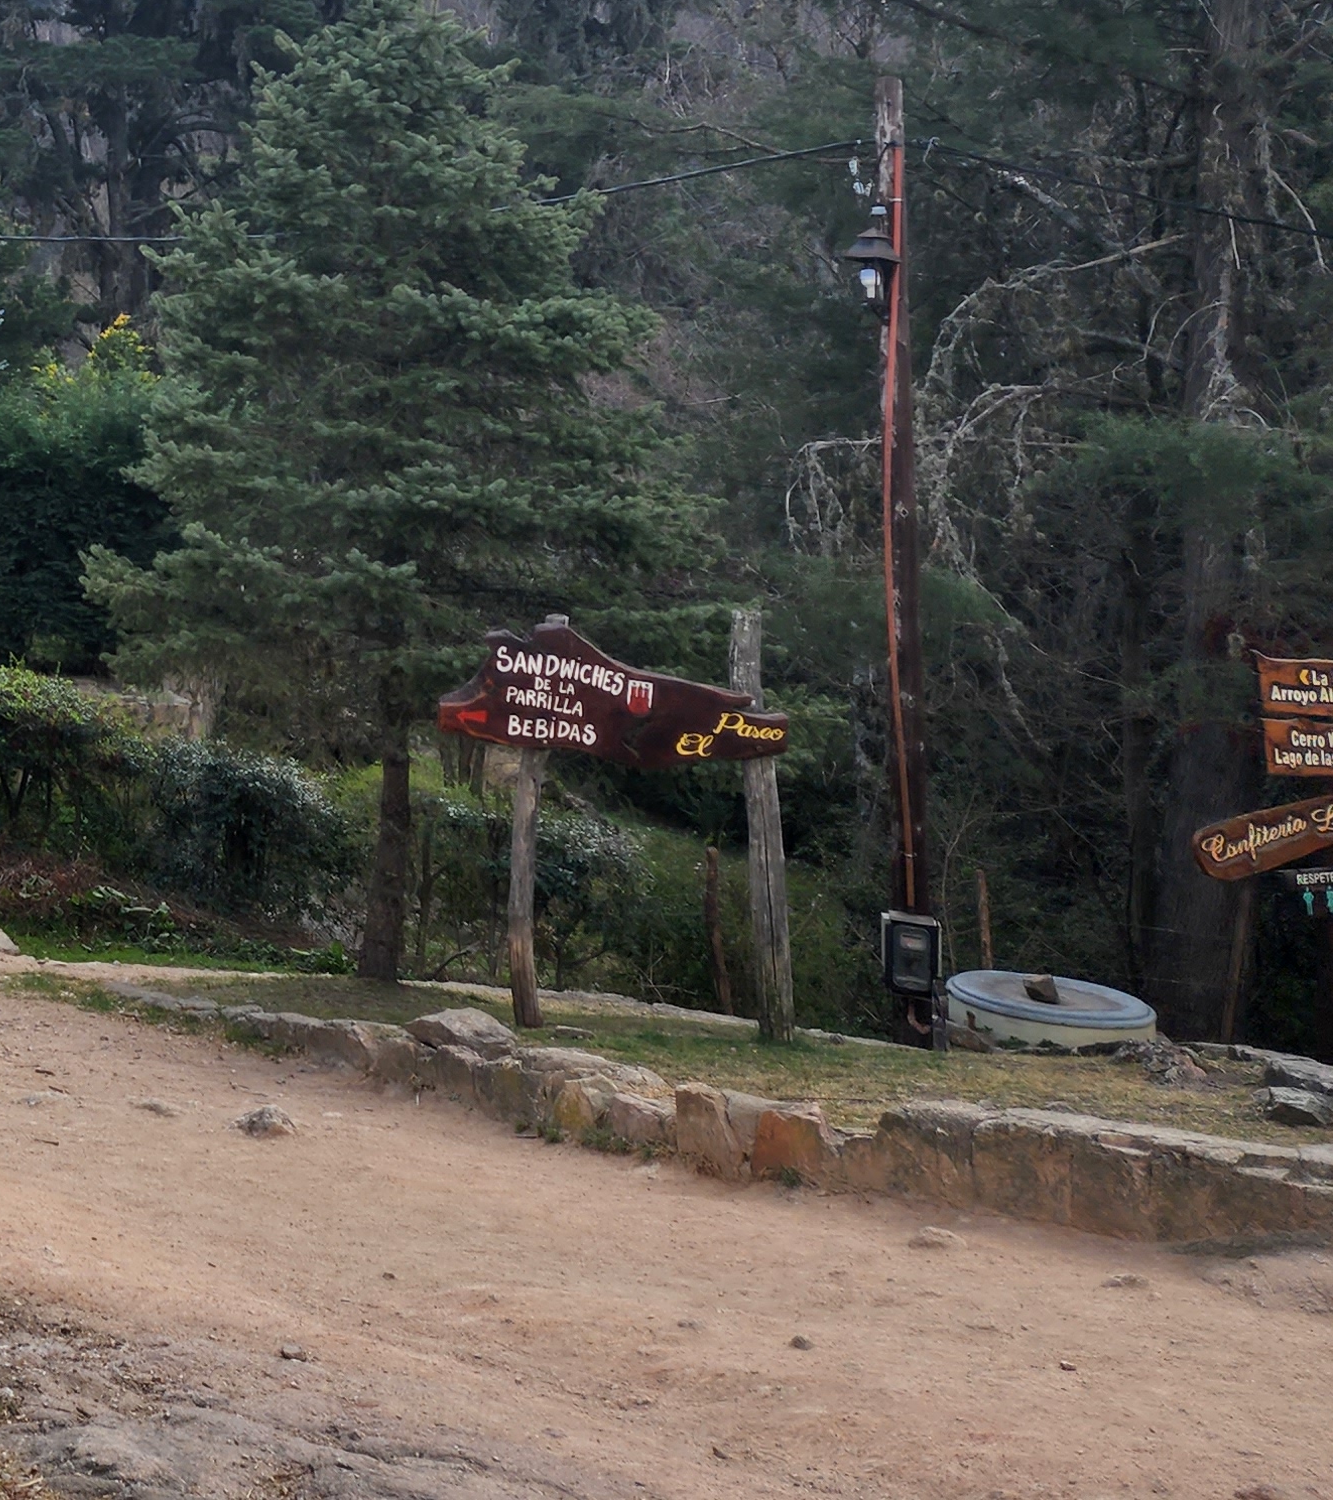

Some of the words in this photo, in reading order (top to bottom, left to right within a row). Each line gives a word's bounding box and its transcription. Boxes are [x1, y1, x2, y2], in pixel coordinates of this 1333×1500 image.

[534, 676, 552, 692] DE
[559, 680, 575, 696] LA
[1311, 669, 1328, 686] La
[1270, 684, 1317, 706] Arroyo
[676, 732, 714, 757] El
[713, 712, 786, 741] Paseo
[1290, 729, 1326, 748] Cerro
[1274, 747, 1303, 769] Lago
[1304, 748, 1320, 766] de
